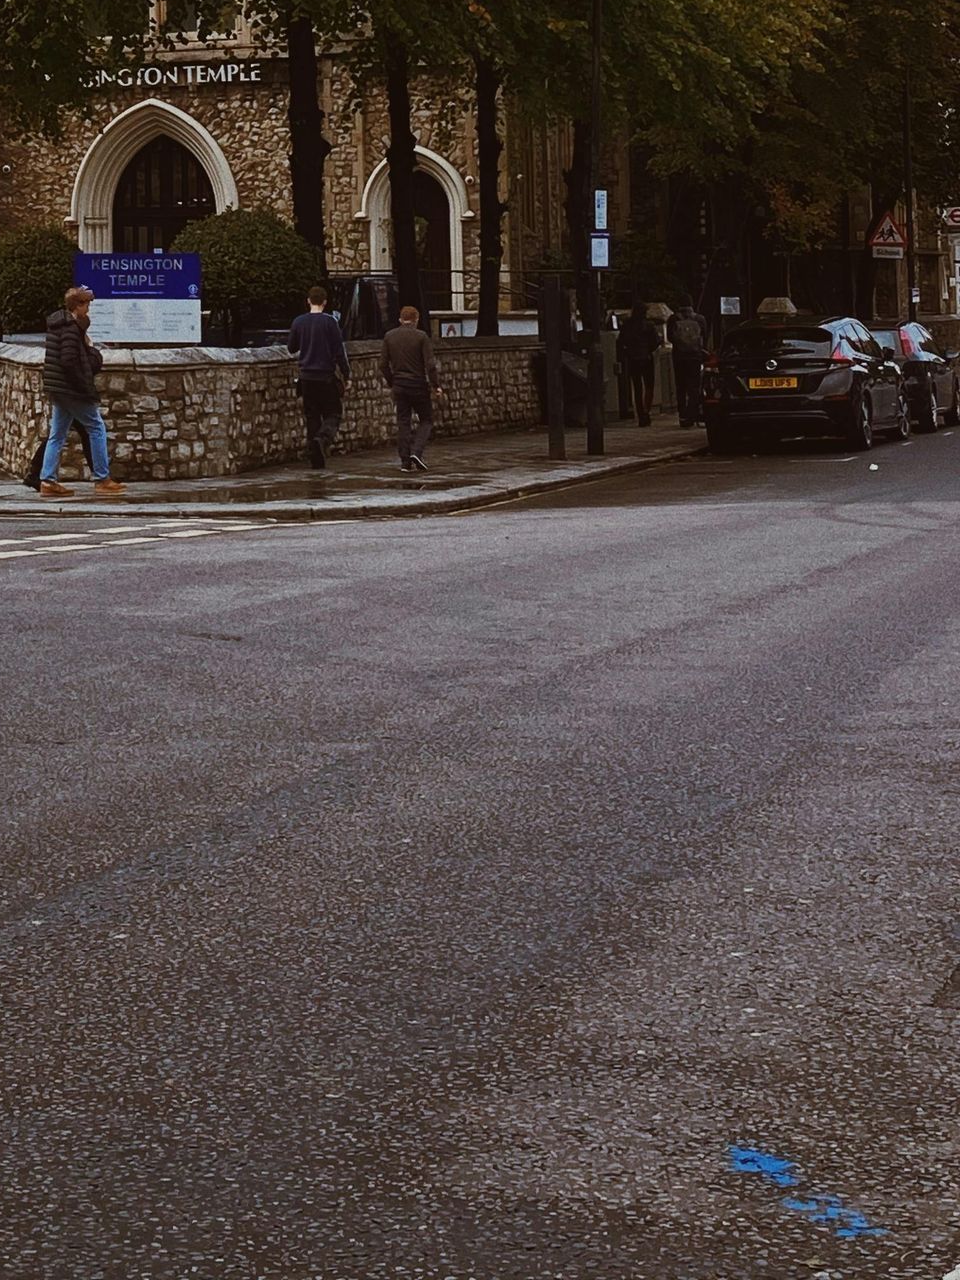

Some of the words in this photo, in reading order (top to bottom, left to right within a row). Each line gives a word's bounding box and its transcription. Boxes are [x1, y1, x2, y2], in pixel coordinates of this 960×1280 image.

[183, 63, 261, 83] TEMPLE
[91, 258, 183, 271] KENSINGTON
[109, 275, 165, 286] TEMPLE
